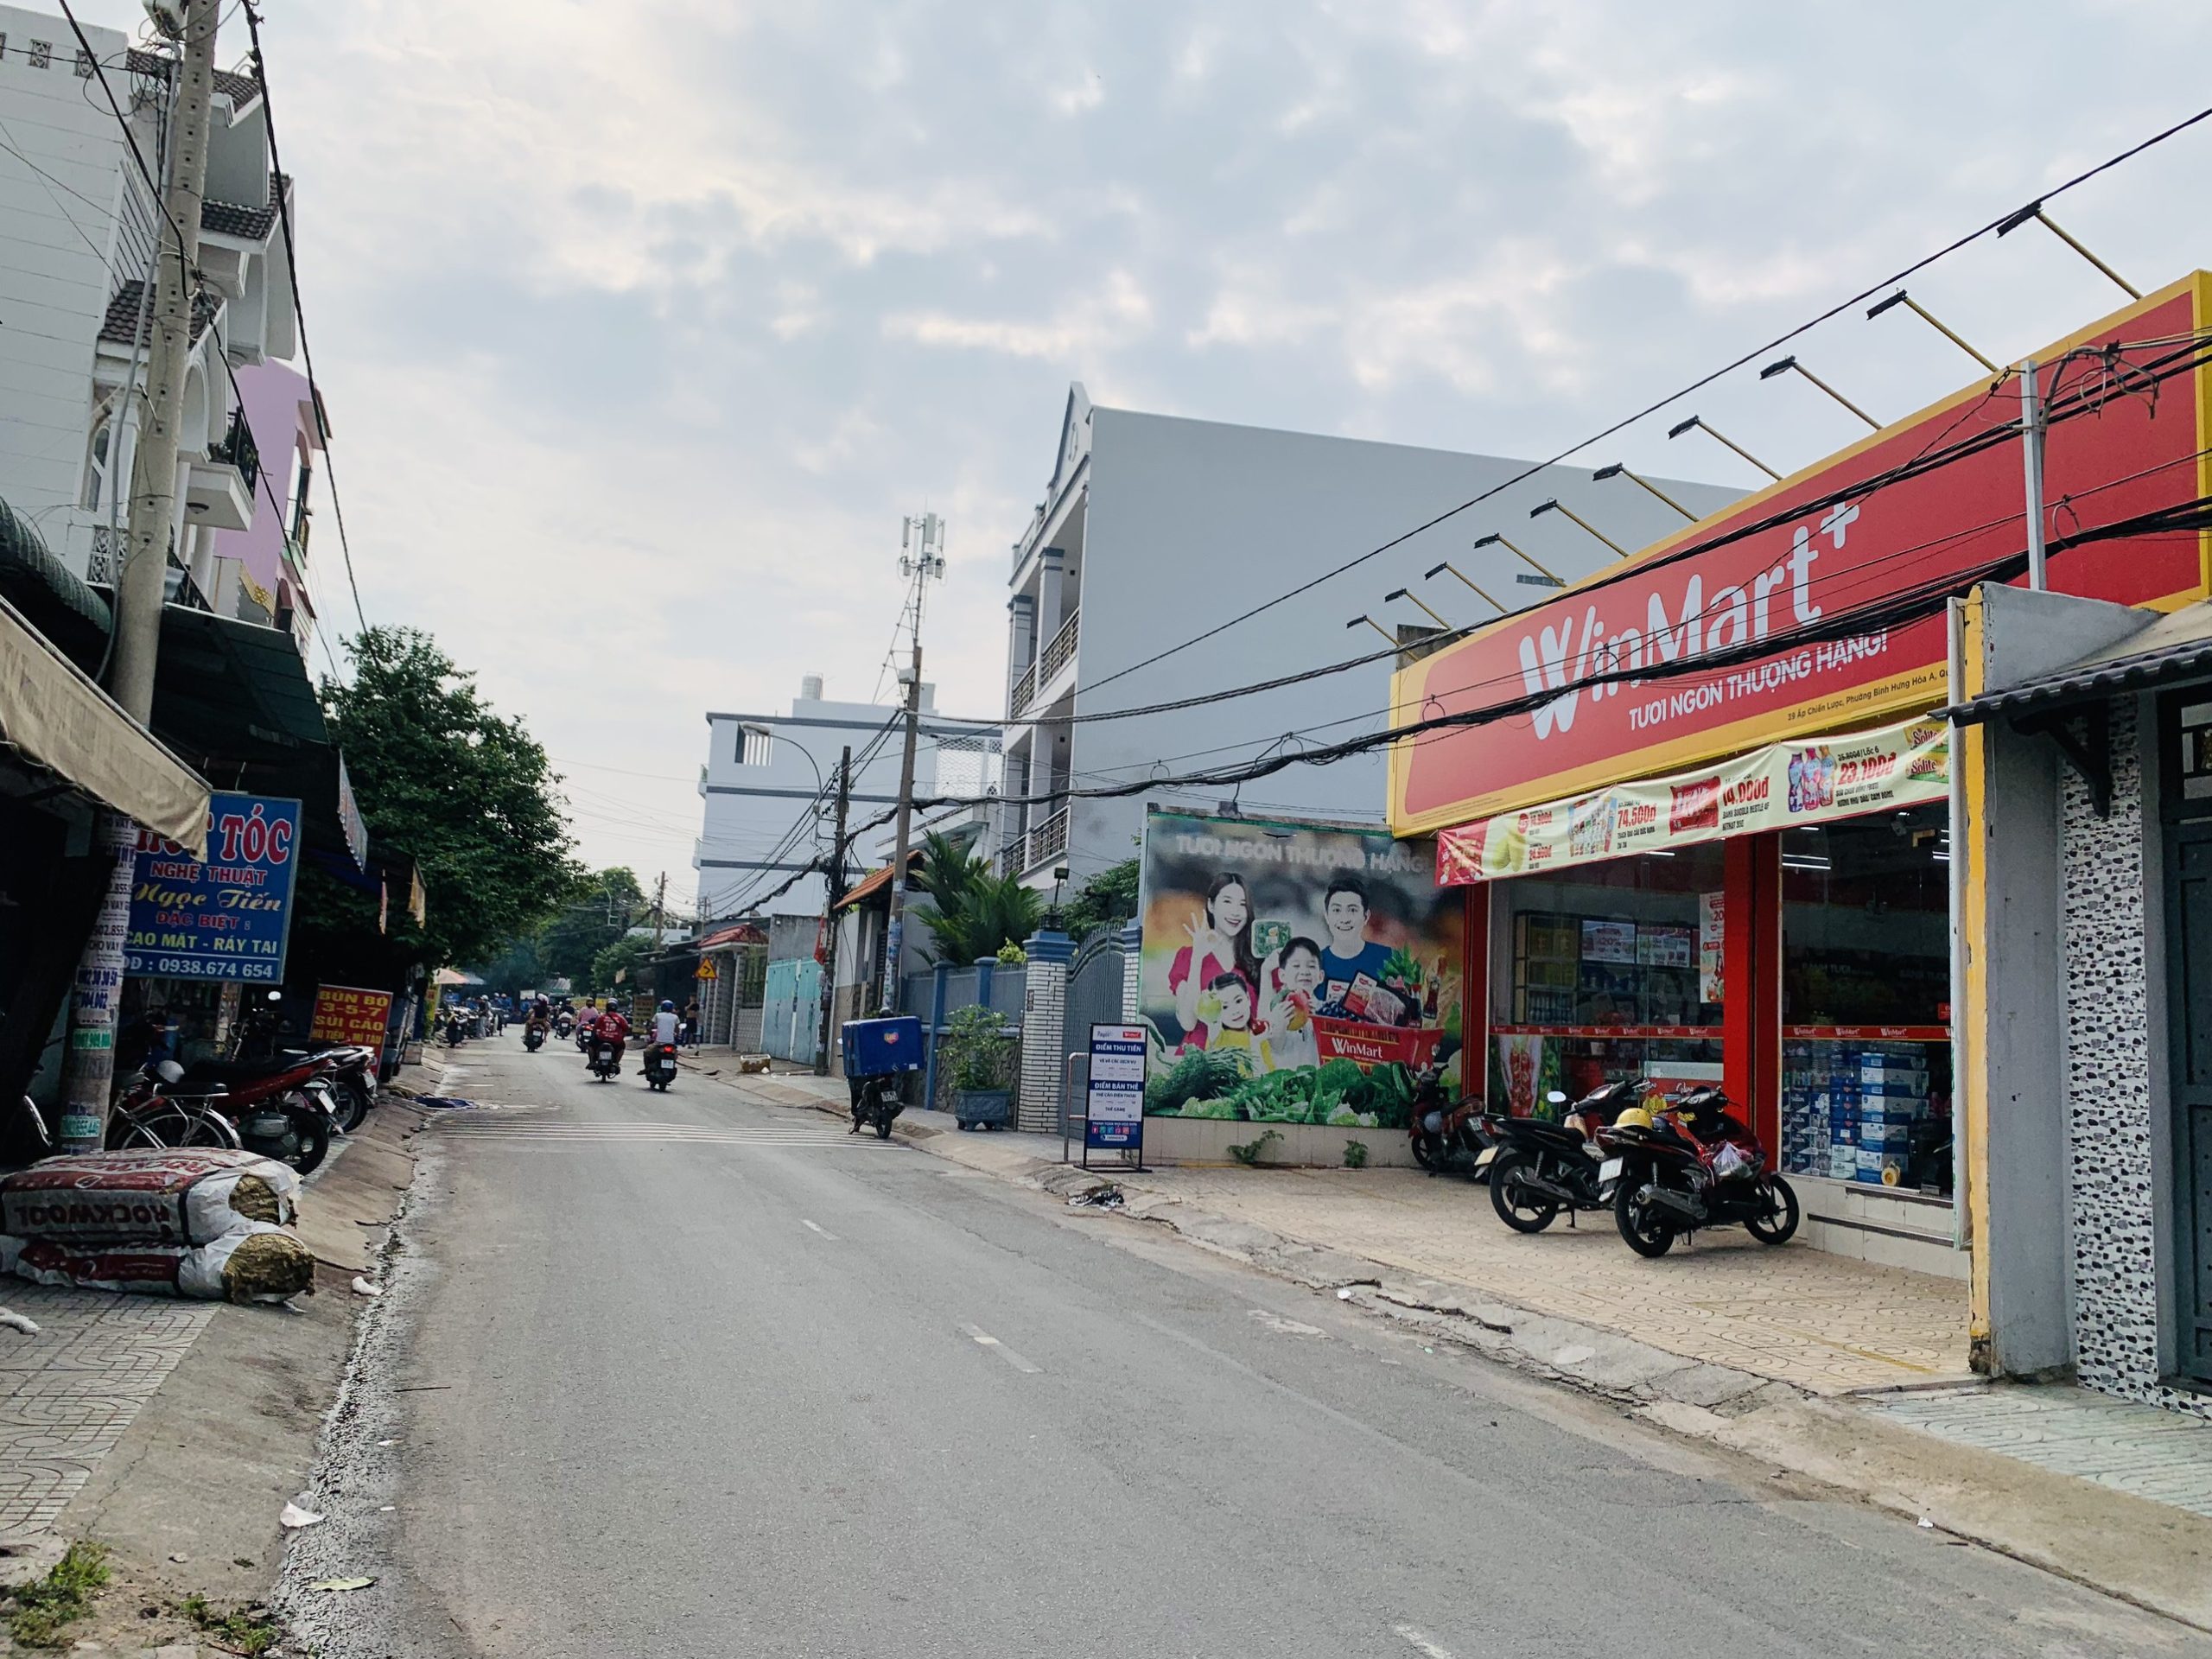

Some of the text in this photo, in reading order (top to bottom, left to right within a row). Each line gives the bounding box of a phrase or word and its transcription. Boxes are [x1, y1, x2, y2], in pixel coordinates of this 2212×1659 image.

[1629, 632, 1887, 731] TƯƠI NGON THƯỢNG HẠNG!
[1787, 712, 1796, 721] 39
[1891, 679, 1910, 693] Hưng
[1929, 671, 1937, 683] A,
[1910, 758, 1937, 775] Solite
[219, 804, 292, 864] TÓC
[1224, 840, 1282, 862] NGON
[150, 861, 267, 887] NGHỆ THUẬT
[131, 882, 207, 909] Ngọc
[217, 888, 282, 912] Tiến
[199, 912, 239, 931] BIỆT
[162, 933, 198, 951] MẶT
[213, 935, 247, 954] RÁY
[251, 939, 276, 955] TAI
[159, 957, 237, 976] 0938.674
[242, 963, 273, 978] 654
[321, 1002, 382, 1017] 3-5-7
[1332, 1037, 1382, 1058] WinMart
